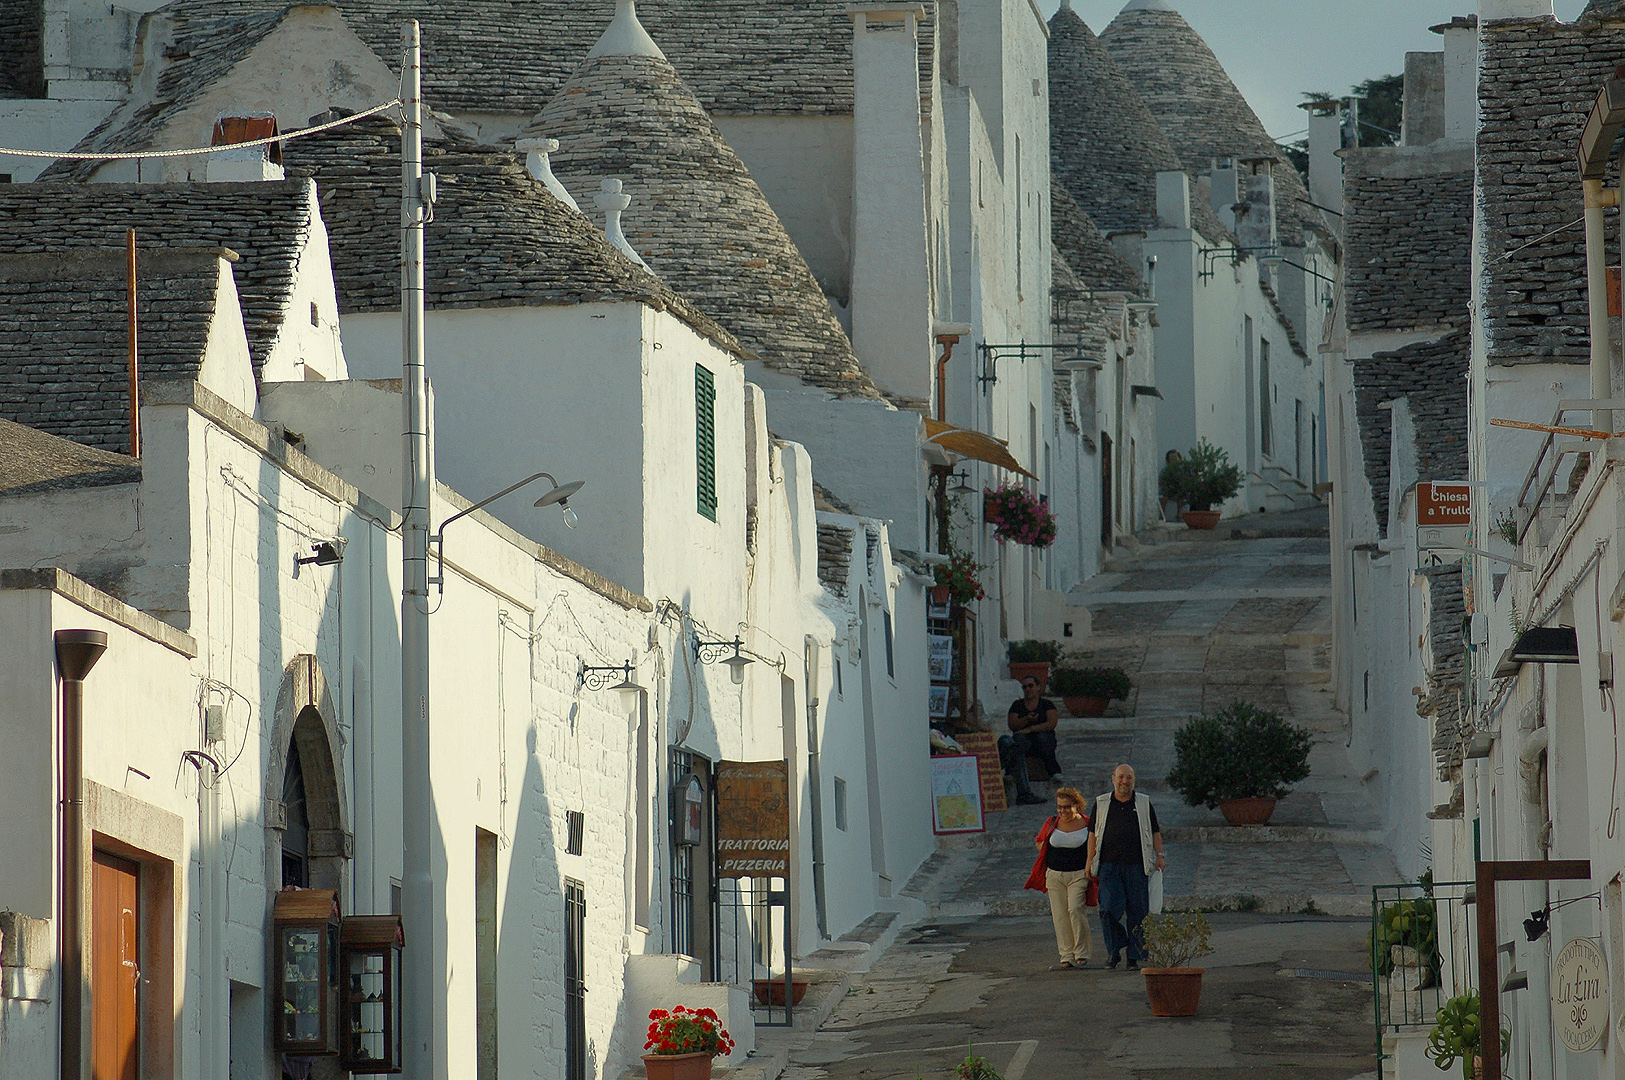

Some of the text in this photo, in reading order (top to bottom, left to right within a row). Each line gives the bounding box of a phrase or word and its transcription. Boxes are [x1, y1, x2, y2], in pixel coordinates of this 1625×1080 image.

[1431, 492, 1468, 501] Chiesa
[718, 840, 789, 850] TRATTORIA
[723, 860, 785, 870] PIZZERIA
[1557, 975, 1571, 1004] La
